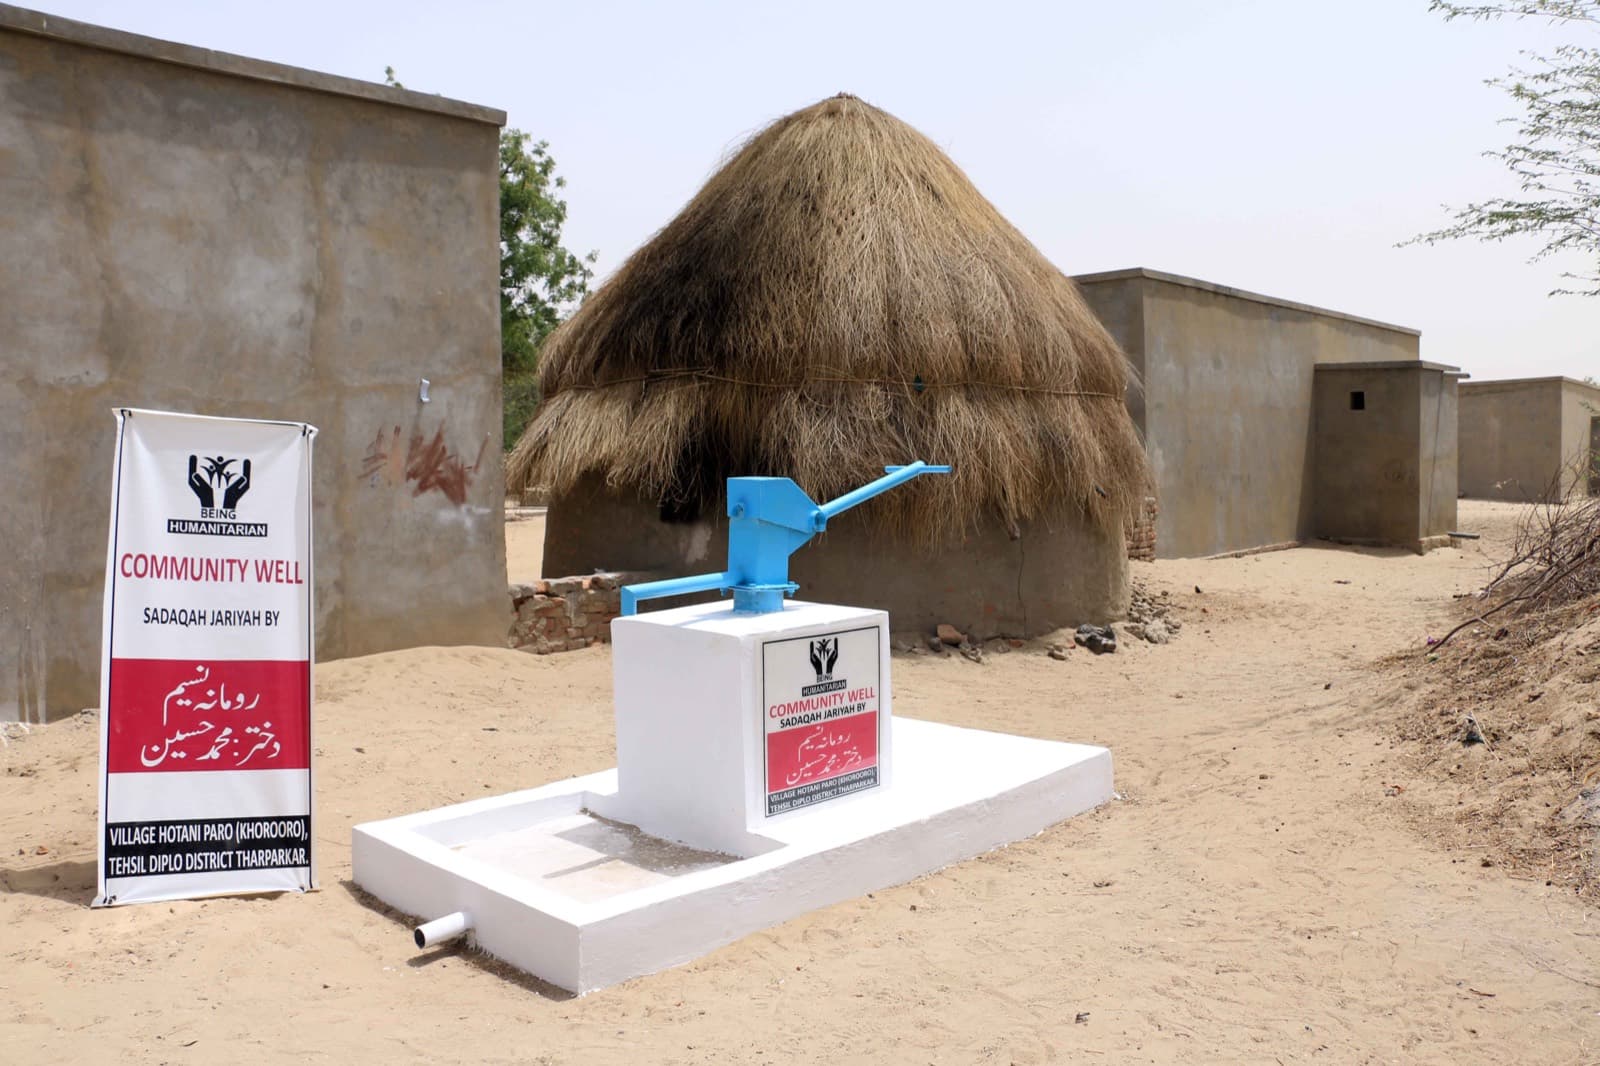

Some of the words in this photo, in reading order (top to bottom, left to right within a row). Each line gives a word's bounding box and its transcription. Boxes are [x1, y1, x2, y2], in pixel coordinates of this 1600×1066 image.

[201, 508, 236, 519] BEING
[170, 521, 266, 536] HUMANITARIAN
[121, 553, 248, 582] COMMUNITY
[255, 559, 303, 584] WELL
[144, 607, 206, 627] SADAQAH
[210, 609, 260, 626] JARIYAH
[266, 611, 280, 626] BY
[803, 681, 846, 695] HUMANITARIAN
[817, 674, 832, 683] BEING
[163, 665, 210, 726] نسیم
[193, 683, 260, 712] رومانہ
[770, 693, 844, 718] COMMUNITY
[848, 687, 875, 701] WELL
[780, 711, 821, 728] SADAQAH
[824, 706, 855, 719] JARIYAH
[857, 702, 866, 712] BY
[770, 788, 796, 801] VILLAGE
[798, 783, 820, 795] HOTANI
[822, 779, 837, 789] PARO
[770, 800, 791, 812] TEHSIL
[793, 796, 810, 807] DIPLO
[812, 789, 837, 802] DISTRICT
[110, 826, 155, 846] VILLAGE
[159, 824, 200, 843] HOTANI
[204, 823, 233, 840] PARO
[109, 857, 146, 874] TEHSIL
[150, 854, 183, 872] DIPLO
[186, 851, 233, 870] DISTRICT
